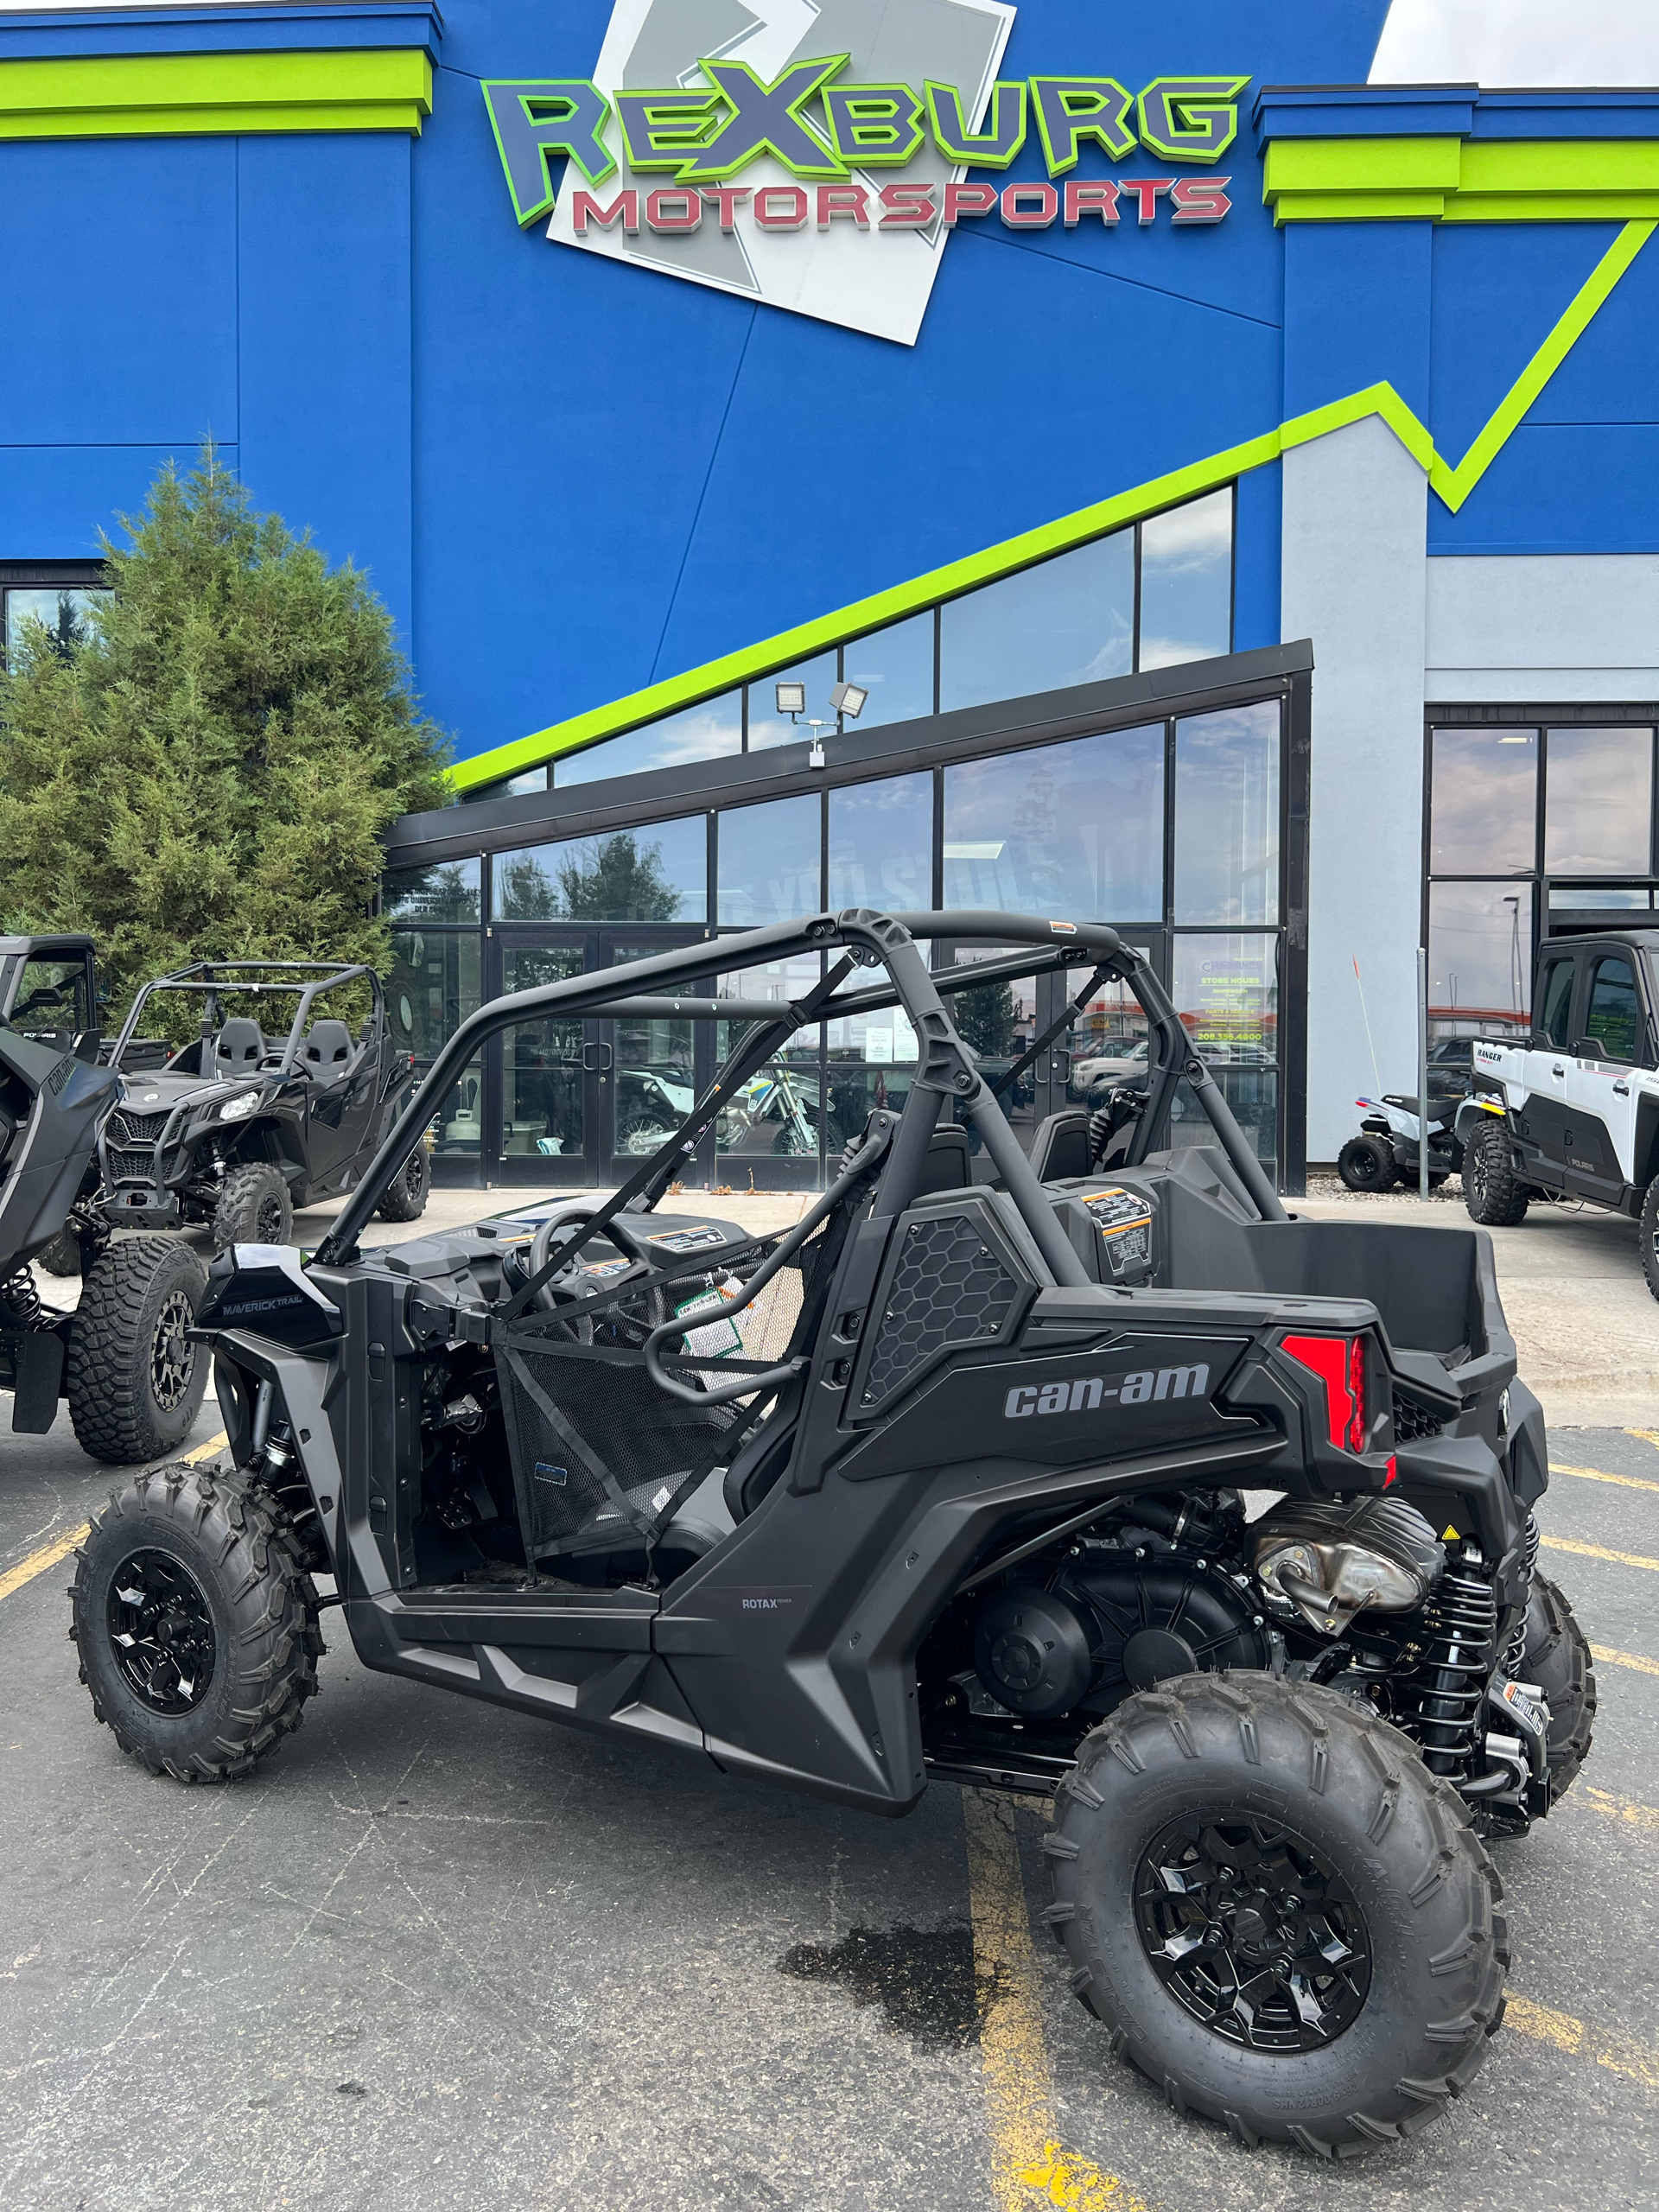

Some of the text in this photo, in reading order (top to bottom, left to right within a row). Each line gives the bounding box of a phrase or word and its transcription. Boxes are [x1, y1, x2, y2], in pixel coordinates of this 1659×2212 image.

[480, 53, 1253, 229] REXBURG
[572, 177, 1232, 236] MOTORSPORTS
[1477, 1048, 1503, 1063] RANGER
[1571, 1158, 1595, 1173] POLARIS
[223, 1296, 303, 1316] MAVERICK TRAIL
[1004, 1363, 1210, 1418] can-am
[742, 1599, 778, 1609] ROTAX
[1078, 1904, 1150, 2045] CARLSTAR
